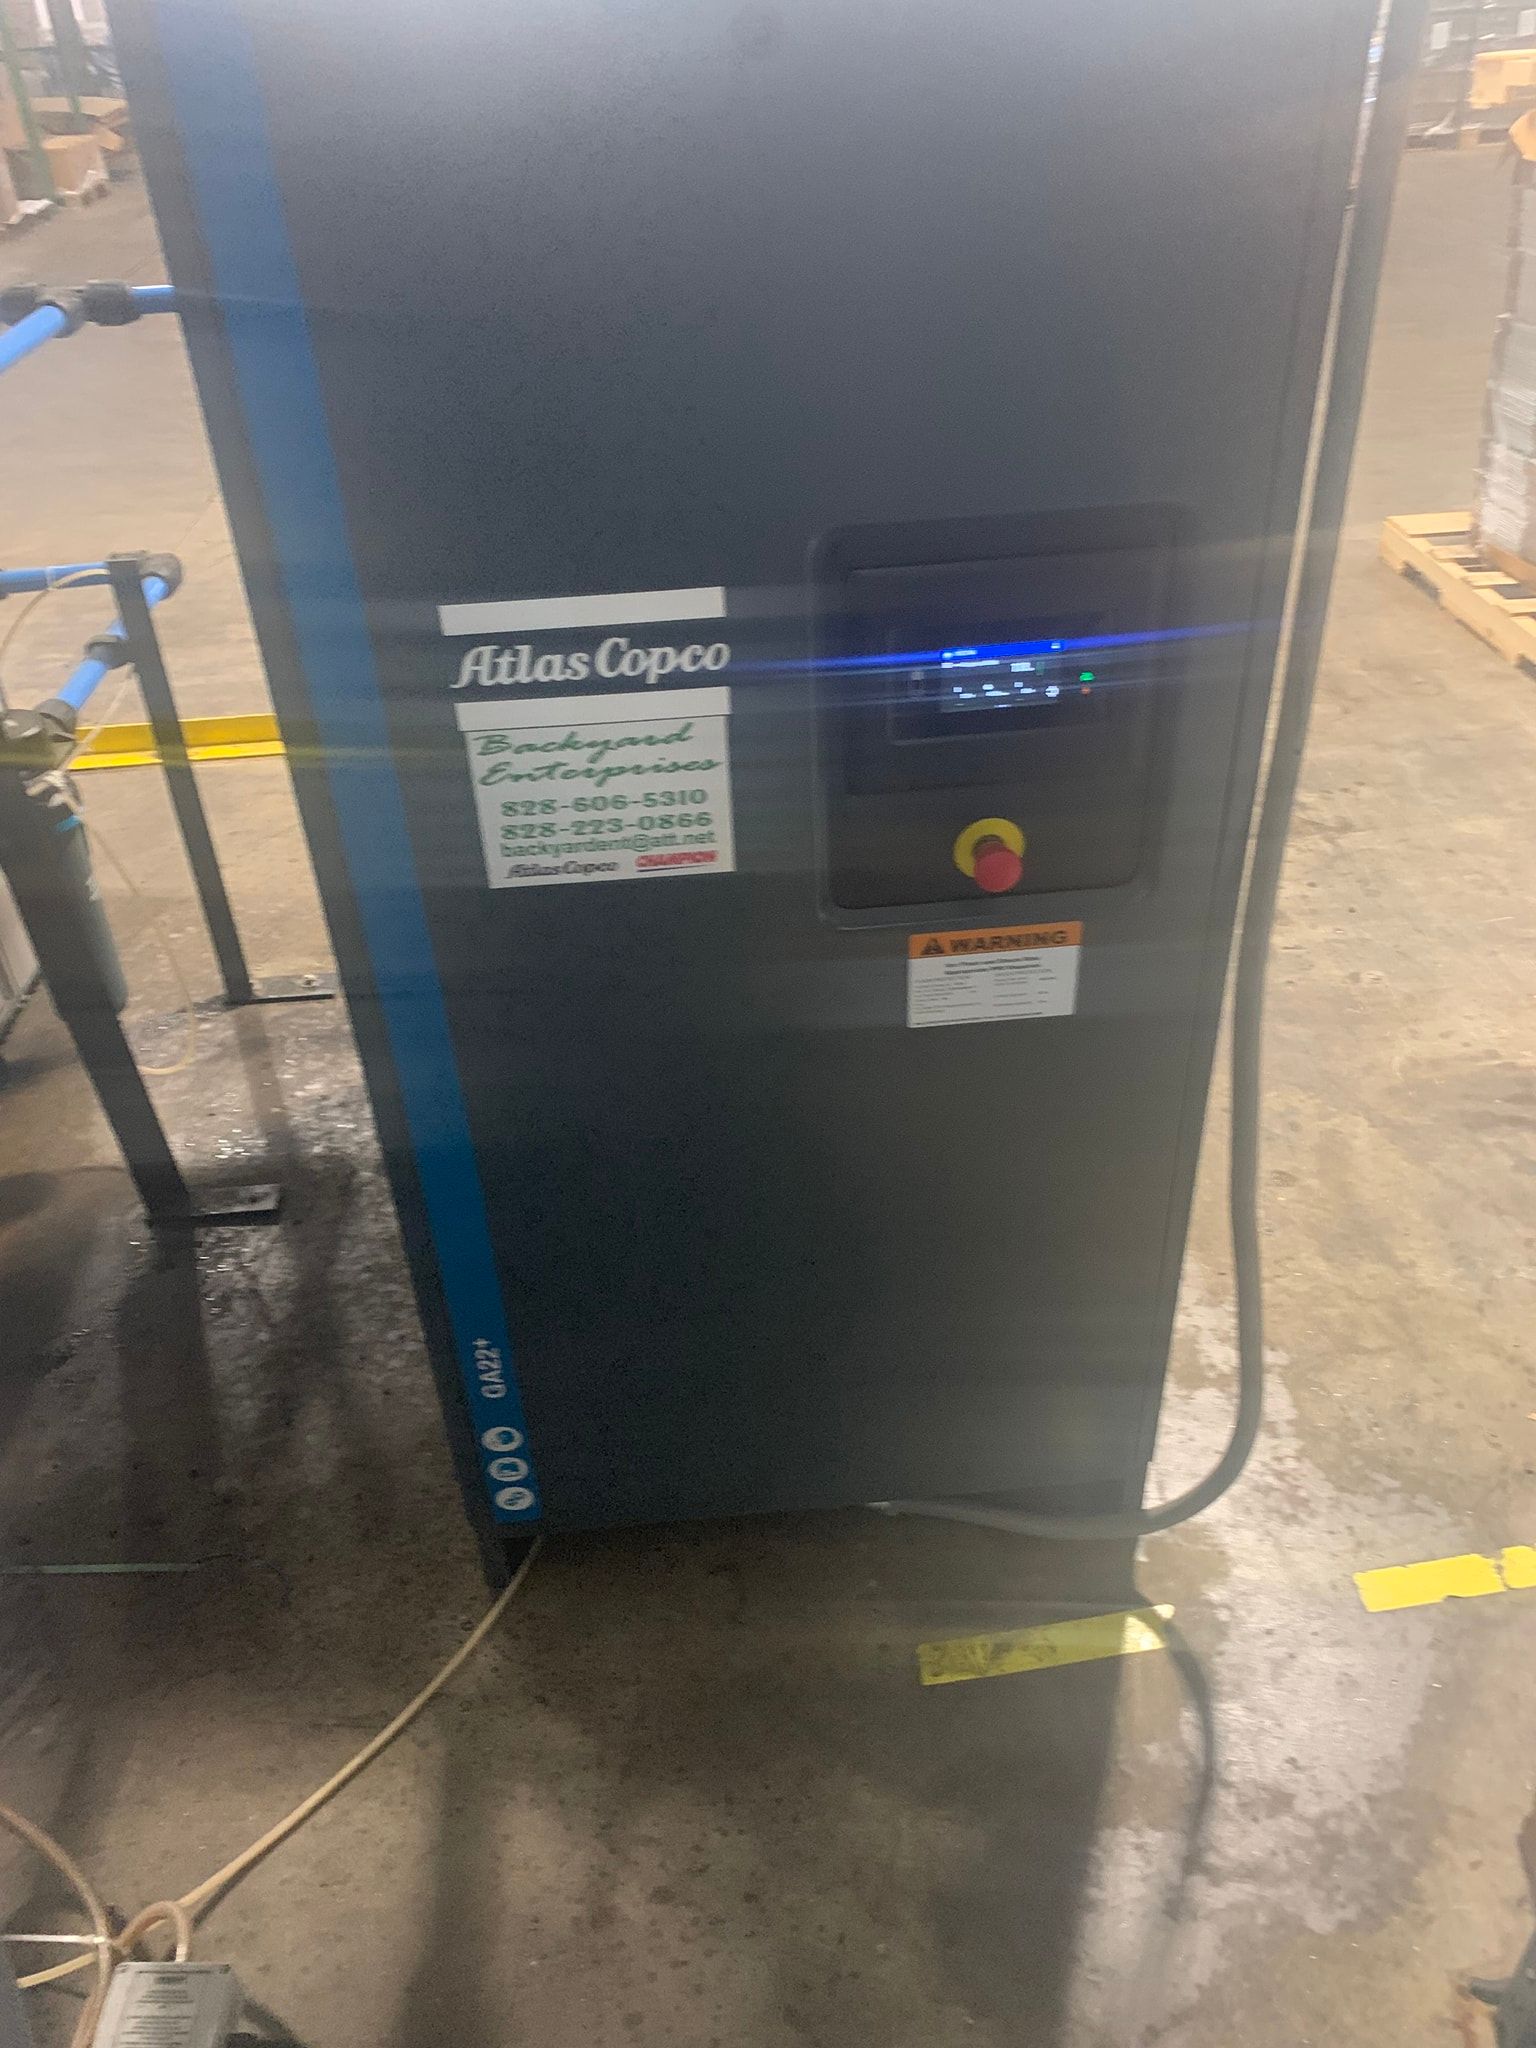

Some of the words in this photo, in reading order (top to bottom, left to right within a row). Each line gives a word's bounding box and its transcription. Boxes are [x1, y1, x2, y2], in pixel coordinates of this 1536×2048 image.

[473, 722, 694, 763] Backyard
[478, 757, 722, 787] Enterprises
[501, 789, 707, 817] 828-606-5310
[501, 812, 712, 840] 828-223-0866
[949, 930, 1068, 952] WARNING
